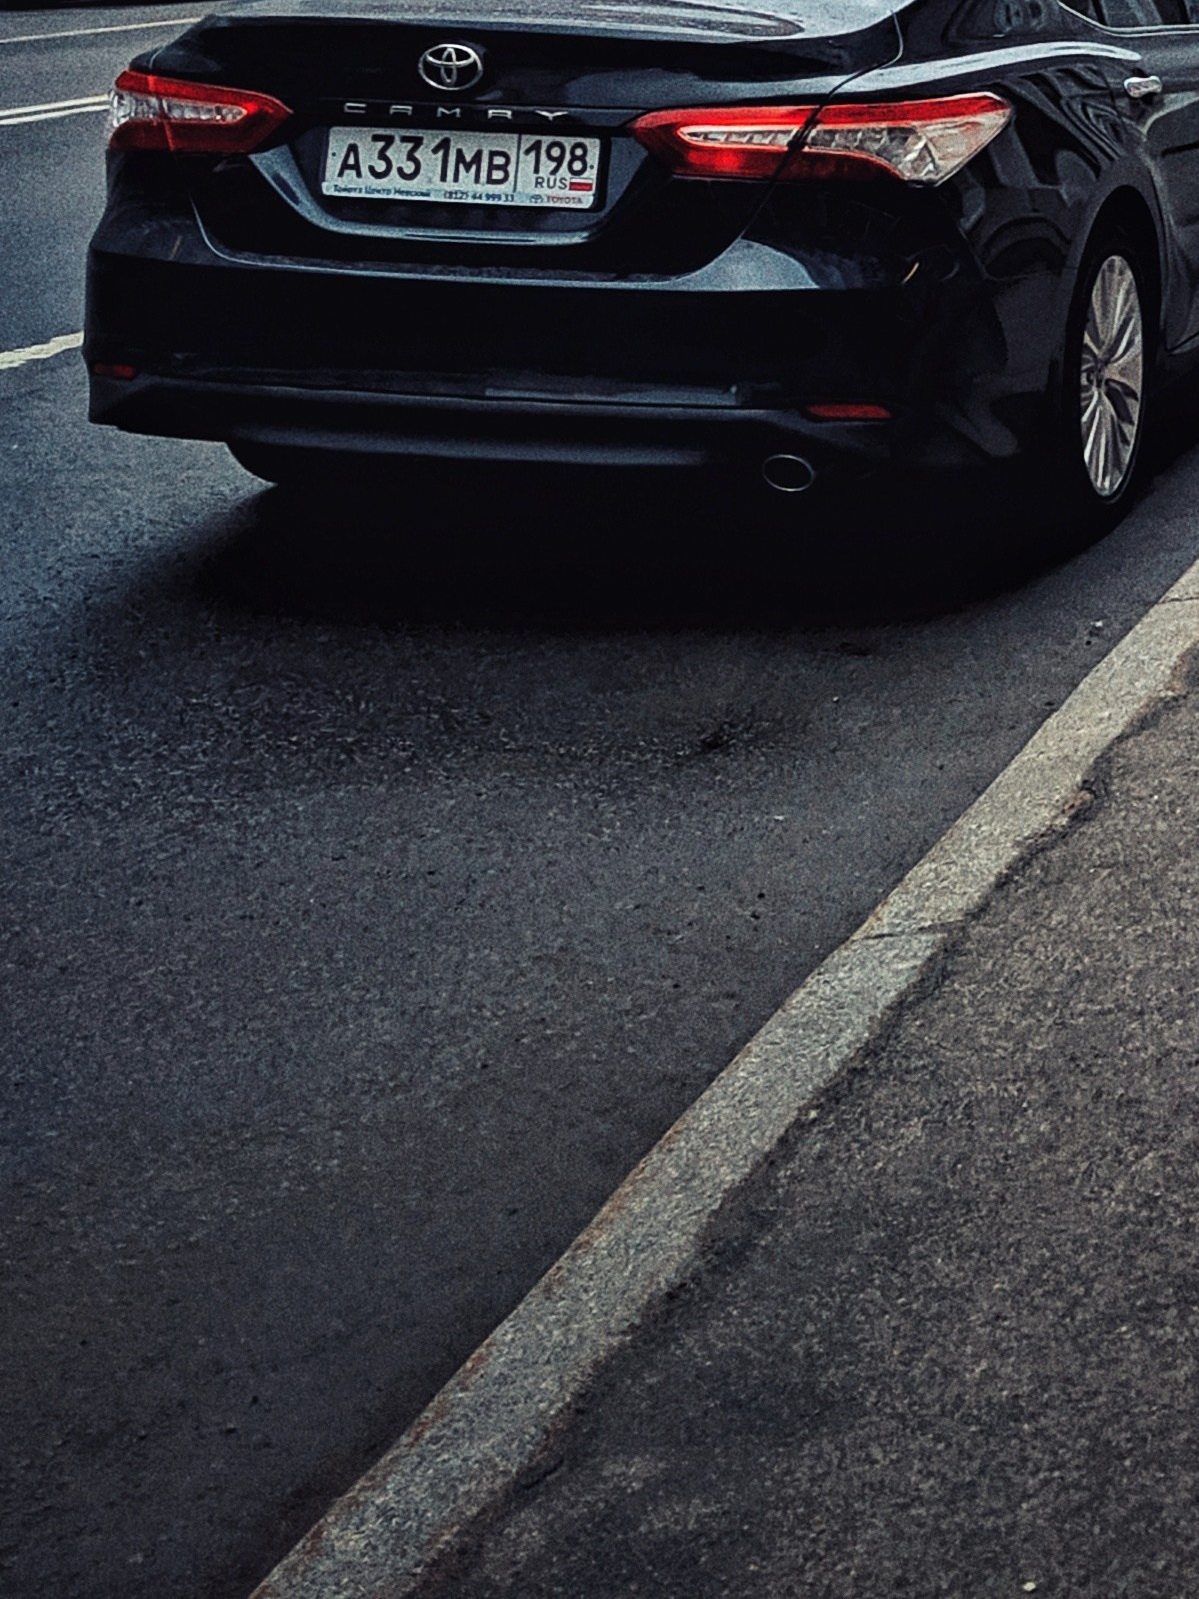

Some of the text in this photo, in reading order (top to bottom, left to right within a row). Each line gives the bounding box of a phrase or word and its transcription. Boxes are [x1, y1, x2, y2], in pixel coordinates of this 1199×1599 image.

[344, 102, 569, 121] CAMRY
[337, 133, 589, 186] А331МВ 198
[534, 176, 568, 191] RUS
[546, 194, 584, 205] TOYOTA
